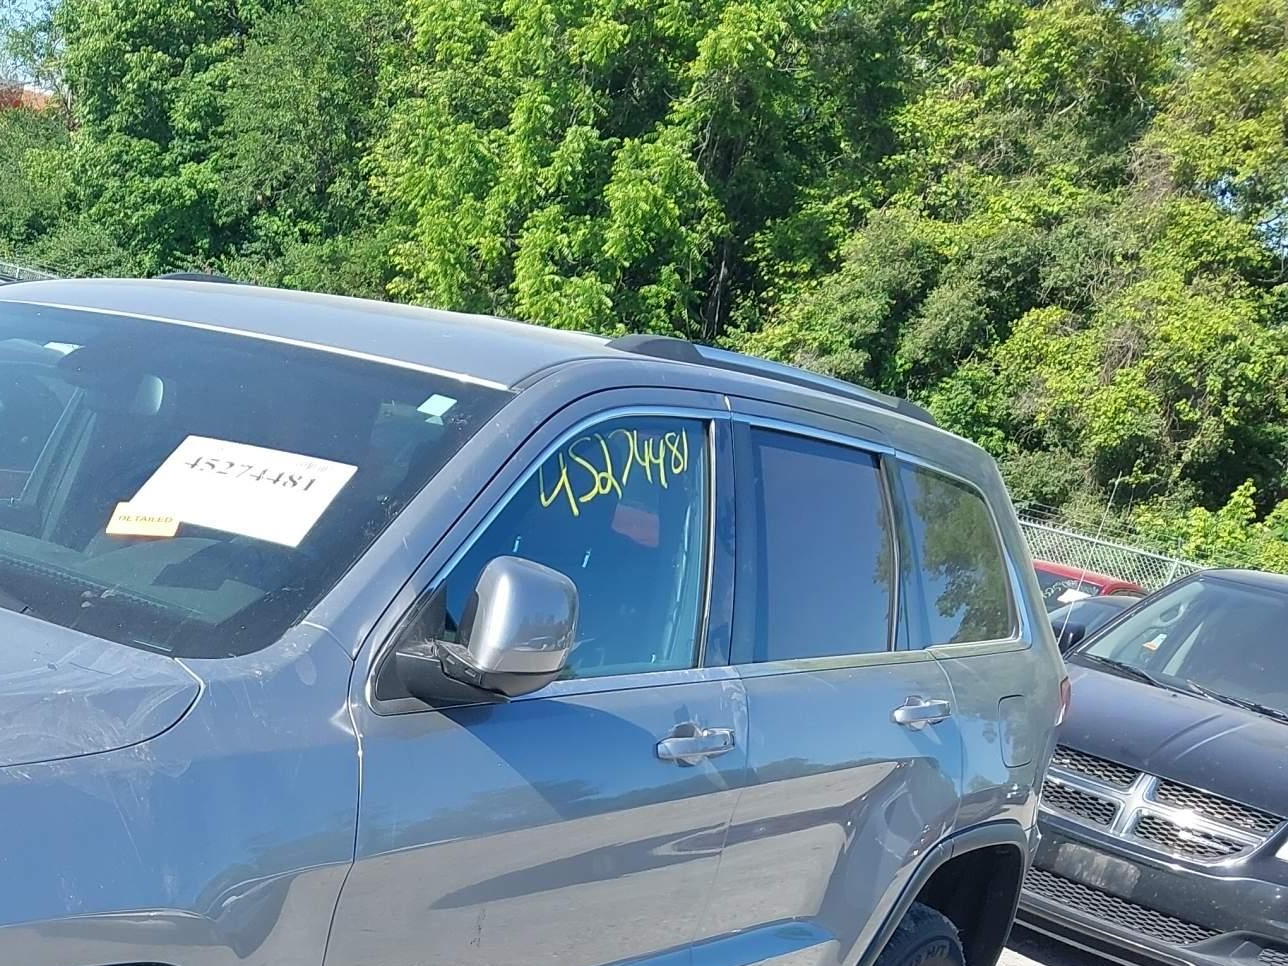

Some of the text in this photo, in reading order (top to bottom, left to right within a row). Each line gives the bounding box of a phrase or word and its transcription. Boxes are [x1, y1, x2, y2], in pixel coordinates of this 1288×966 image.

[185, 456, 316, 491] 45274481
[538, 427, 688, 517] 45274481
[118, 515, 174, 523] DETAILED
